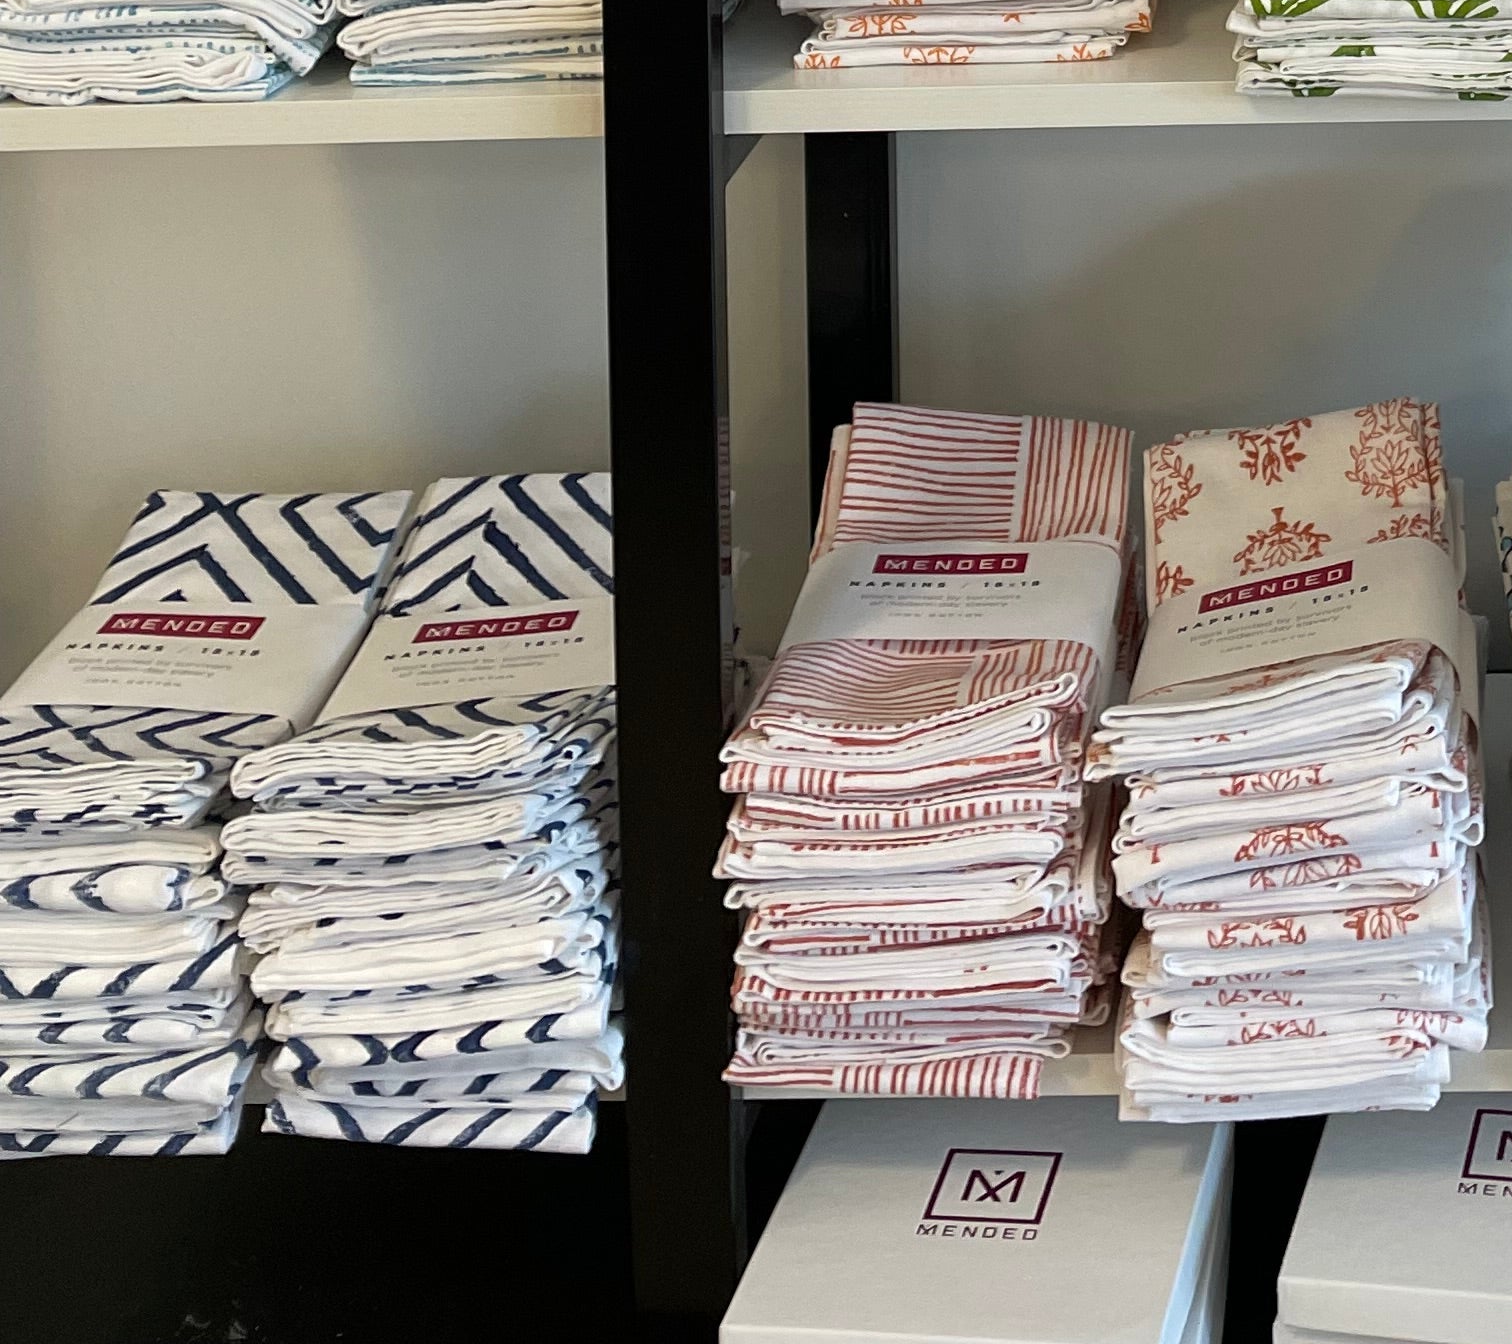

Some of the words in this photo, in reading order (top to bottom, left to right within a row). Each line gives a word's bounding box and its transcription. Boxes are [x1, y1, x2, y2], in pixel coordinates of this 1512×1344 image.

[884, 558, 1019, 571] MENDED
[1209, 568, 1344, 607] MENDED
[111, 617, 252, 634] MENDED
[425, 616, 568, 638] MENDED
[1177, 606, 1274, 633] NAPKINS
[916, 1223, 1039, 1241] MENDED
